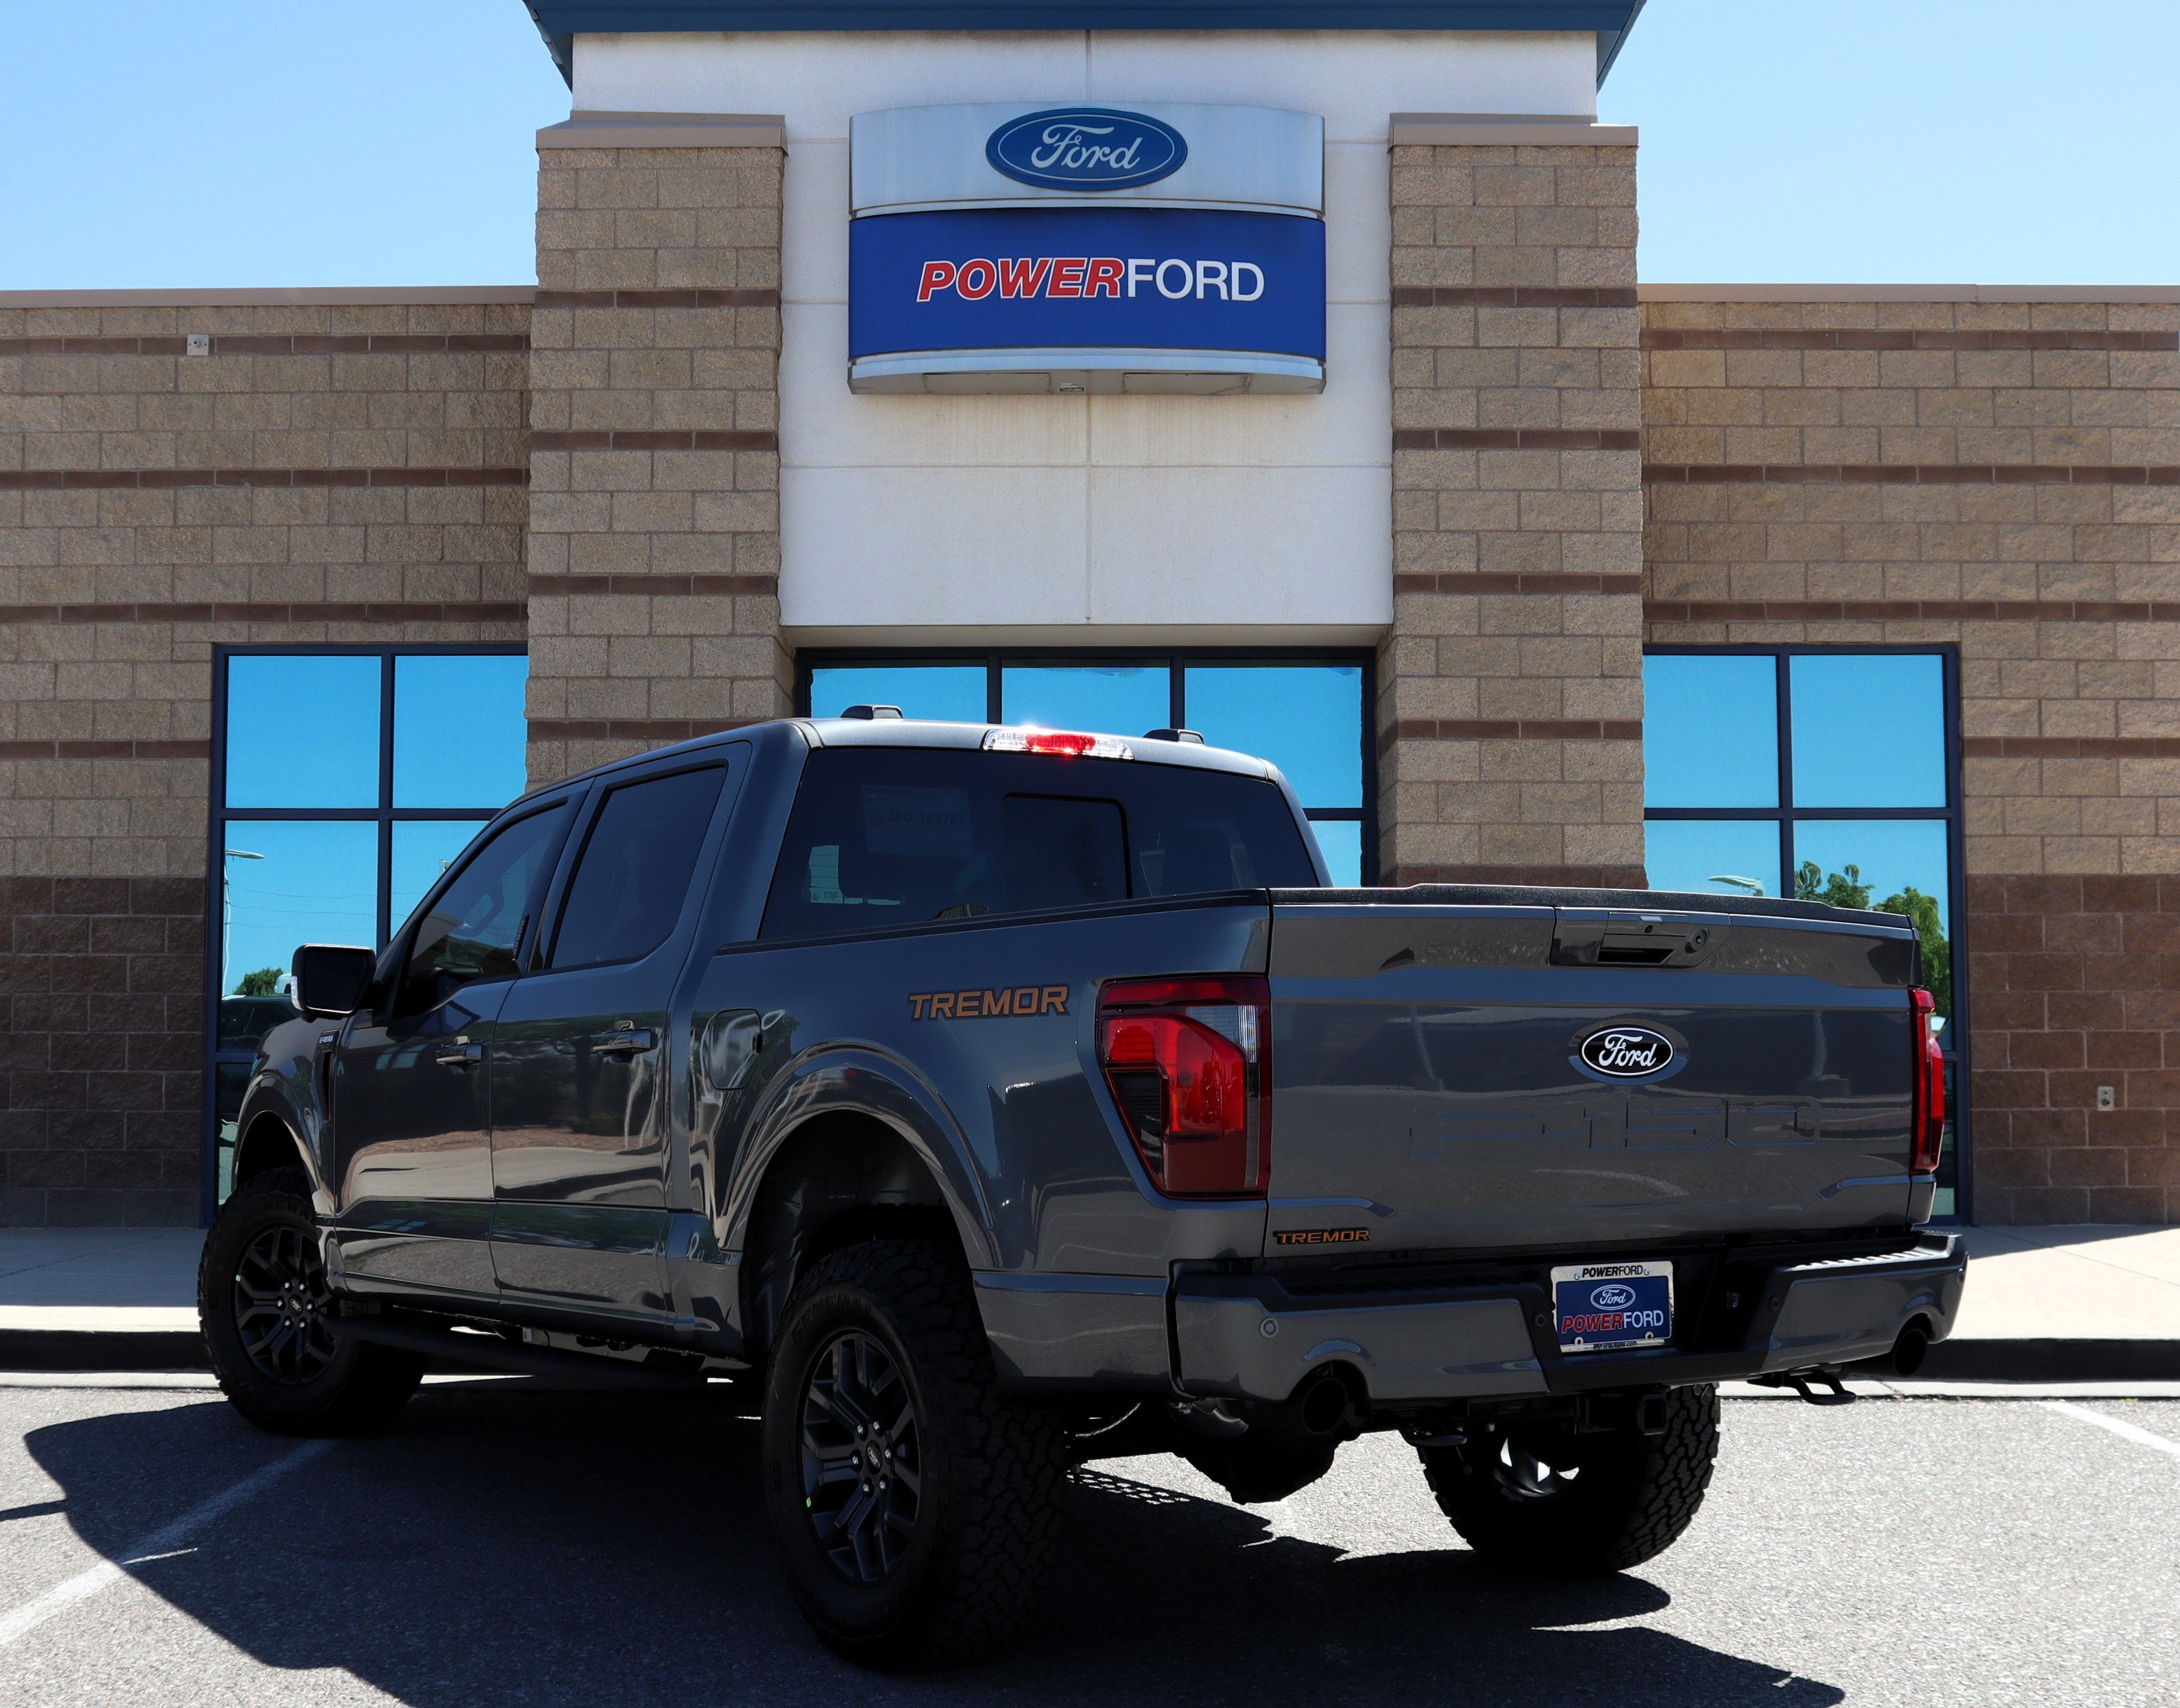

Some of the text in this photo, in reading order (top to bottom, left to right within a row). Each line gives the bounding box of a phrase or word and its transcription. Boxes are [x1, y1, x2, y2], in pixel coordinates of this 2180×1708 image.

[1030, 123, 1144, 170] Ford
[917, 257, 1265, 302] POWERFORD
[909, 986, 1068, 1020] TREMOR
[1599, 1034, 1657, 1066] Ford
[1274, 1228, 1370, 1245] TREMOR
[1582, 1265, 1644, 1278] POWERFORD
[1599, 1289, 1626, 1305] Ford
[1561, 1310, 1664, 1334] POWERFORD
